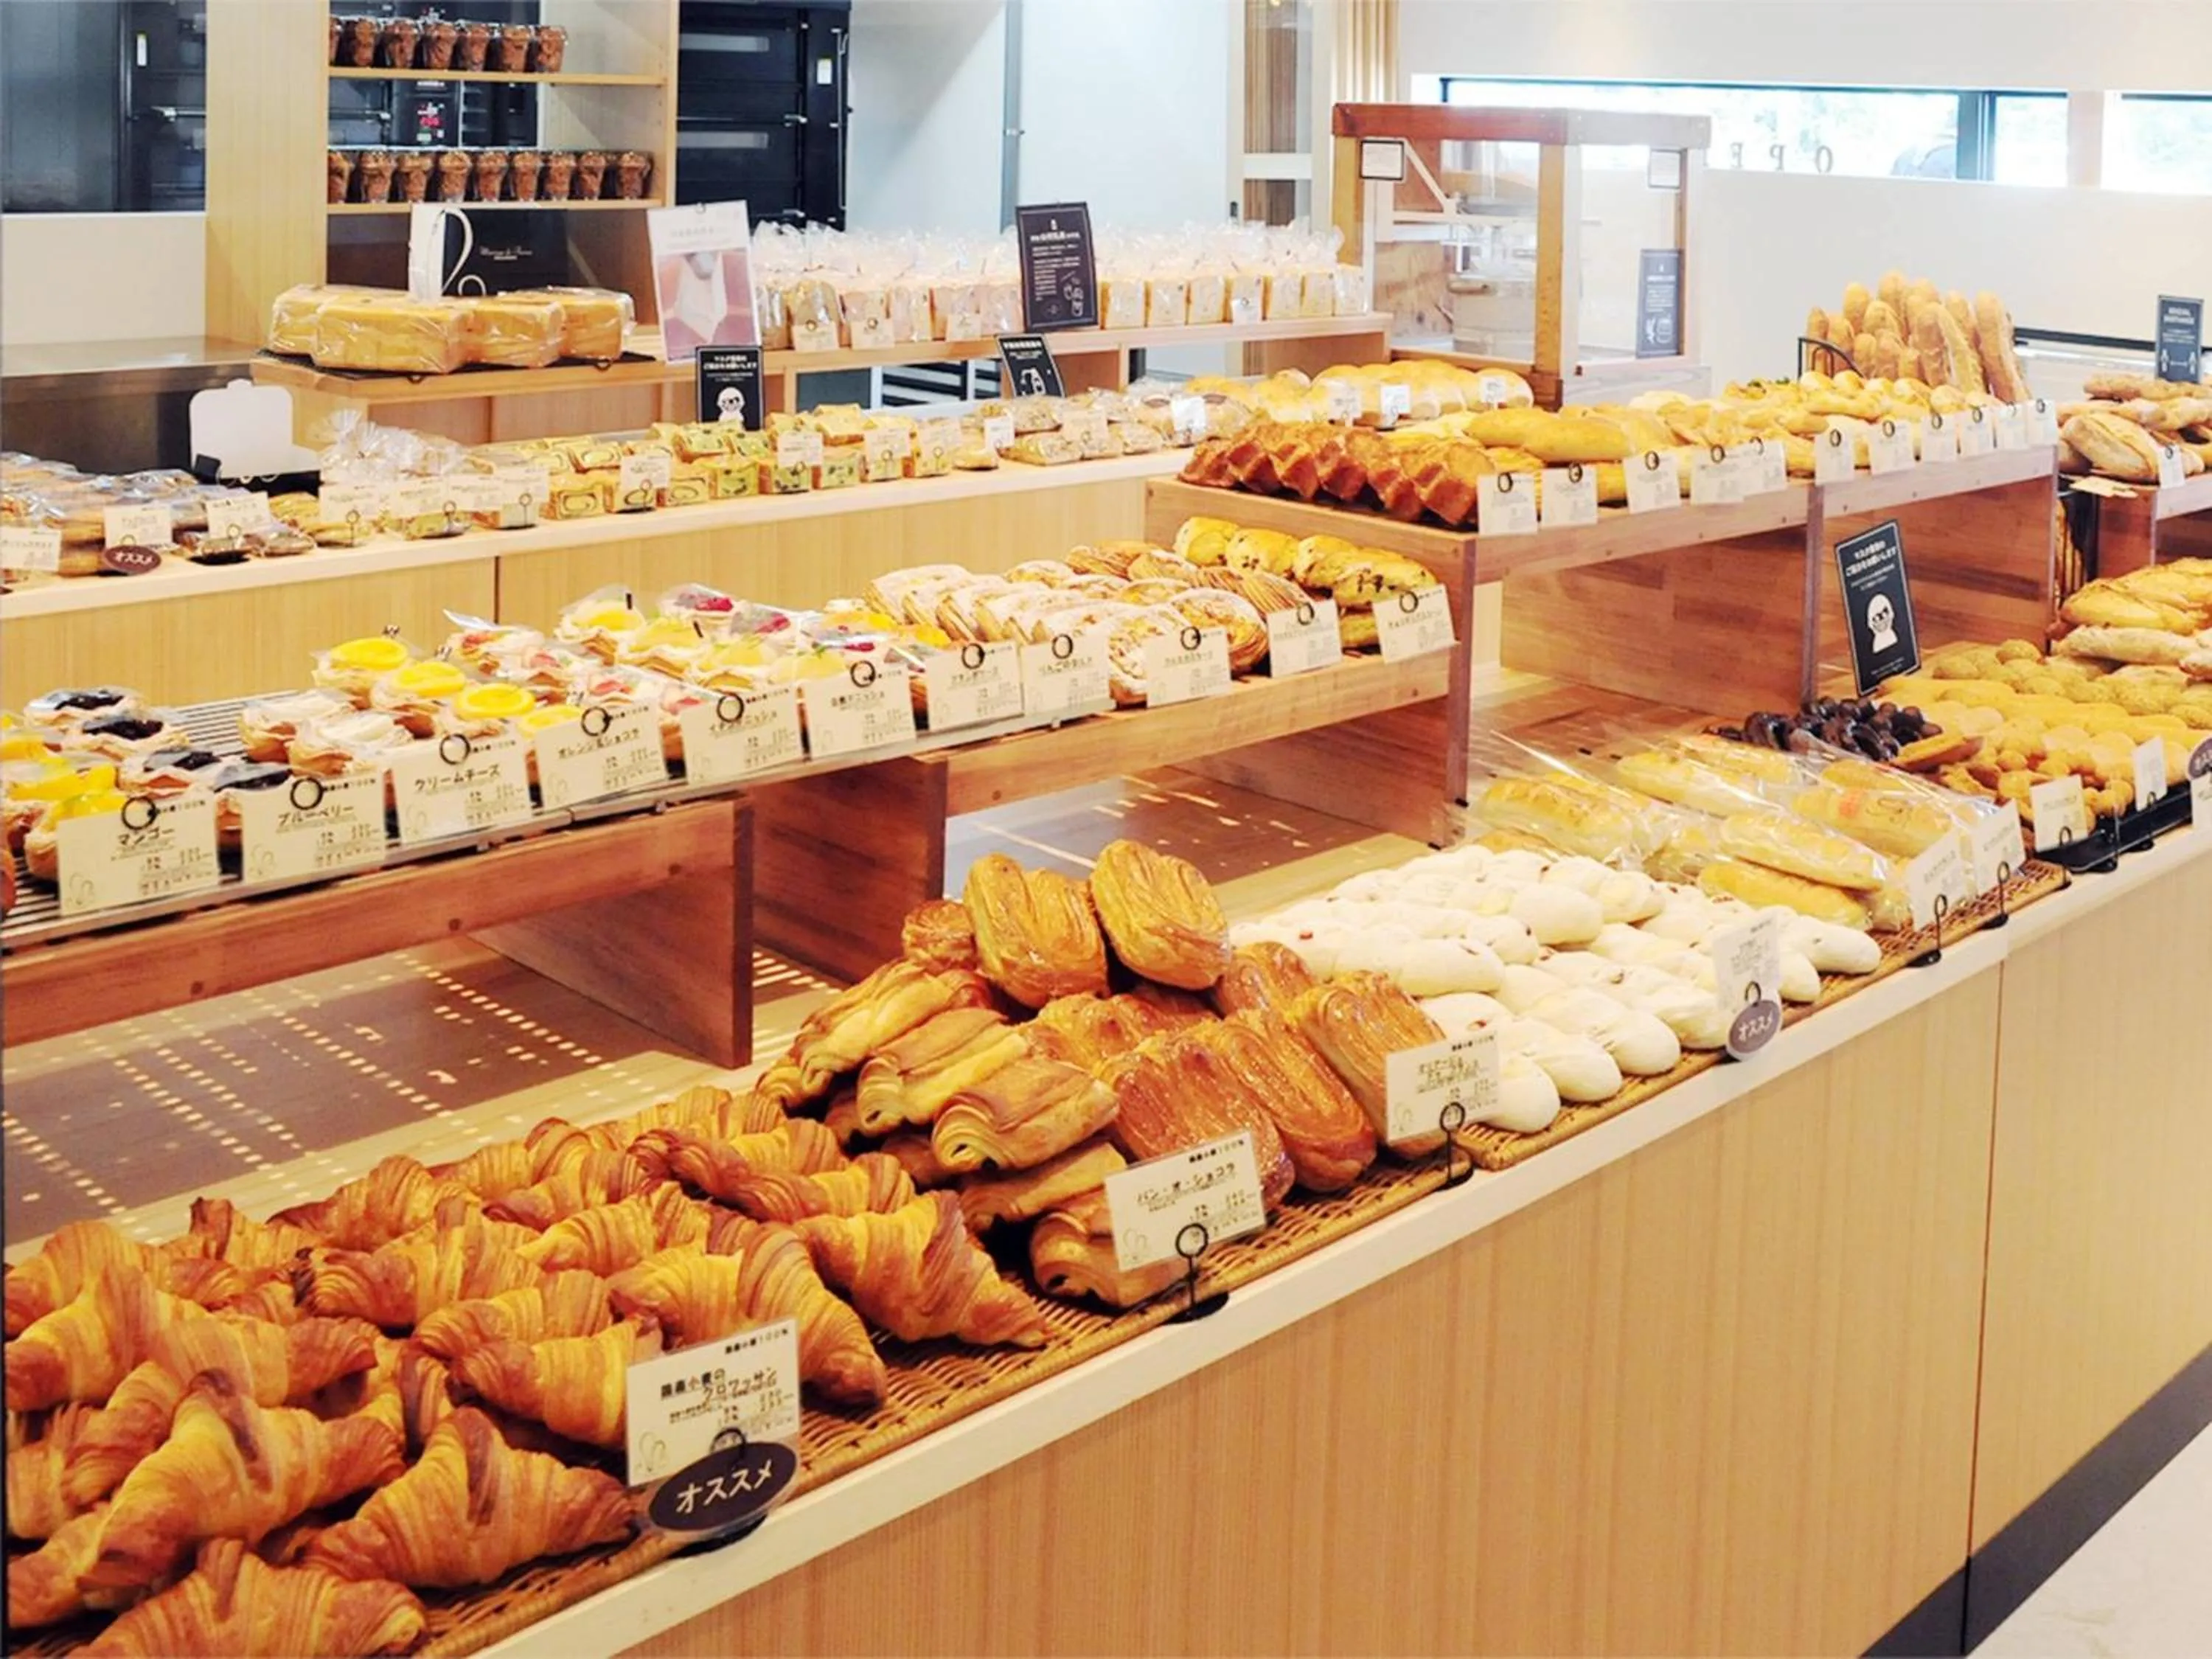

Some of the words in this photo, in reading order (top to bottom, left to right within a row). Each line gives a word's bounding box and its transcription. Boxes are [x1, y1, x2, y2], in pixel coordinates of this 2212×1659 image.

[414, 763, 500, 790] クリームチーズ
[676, 1459, 773, 1514] オススメ
